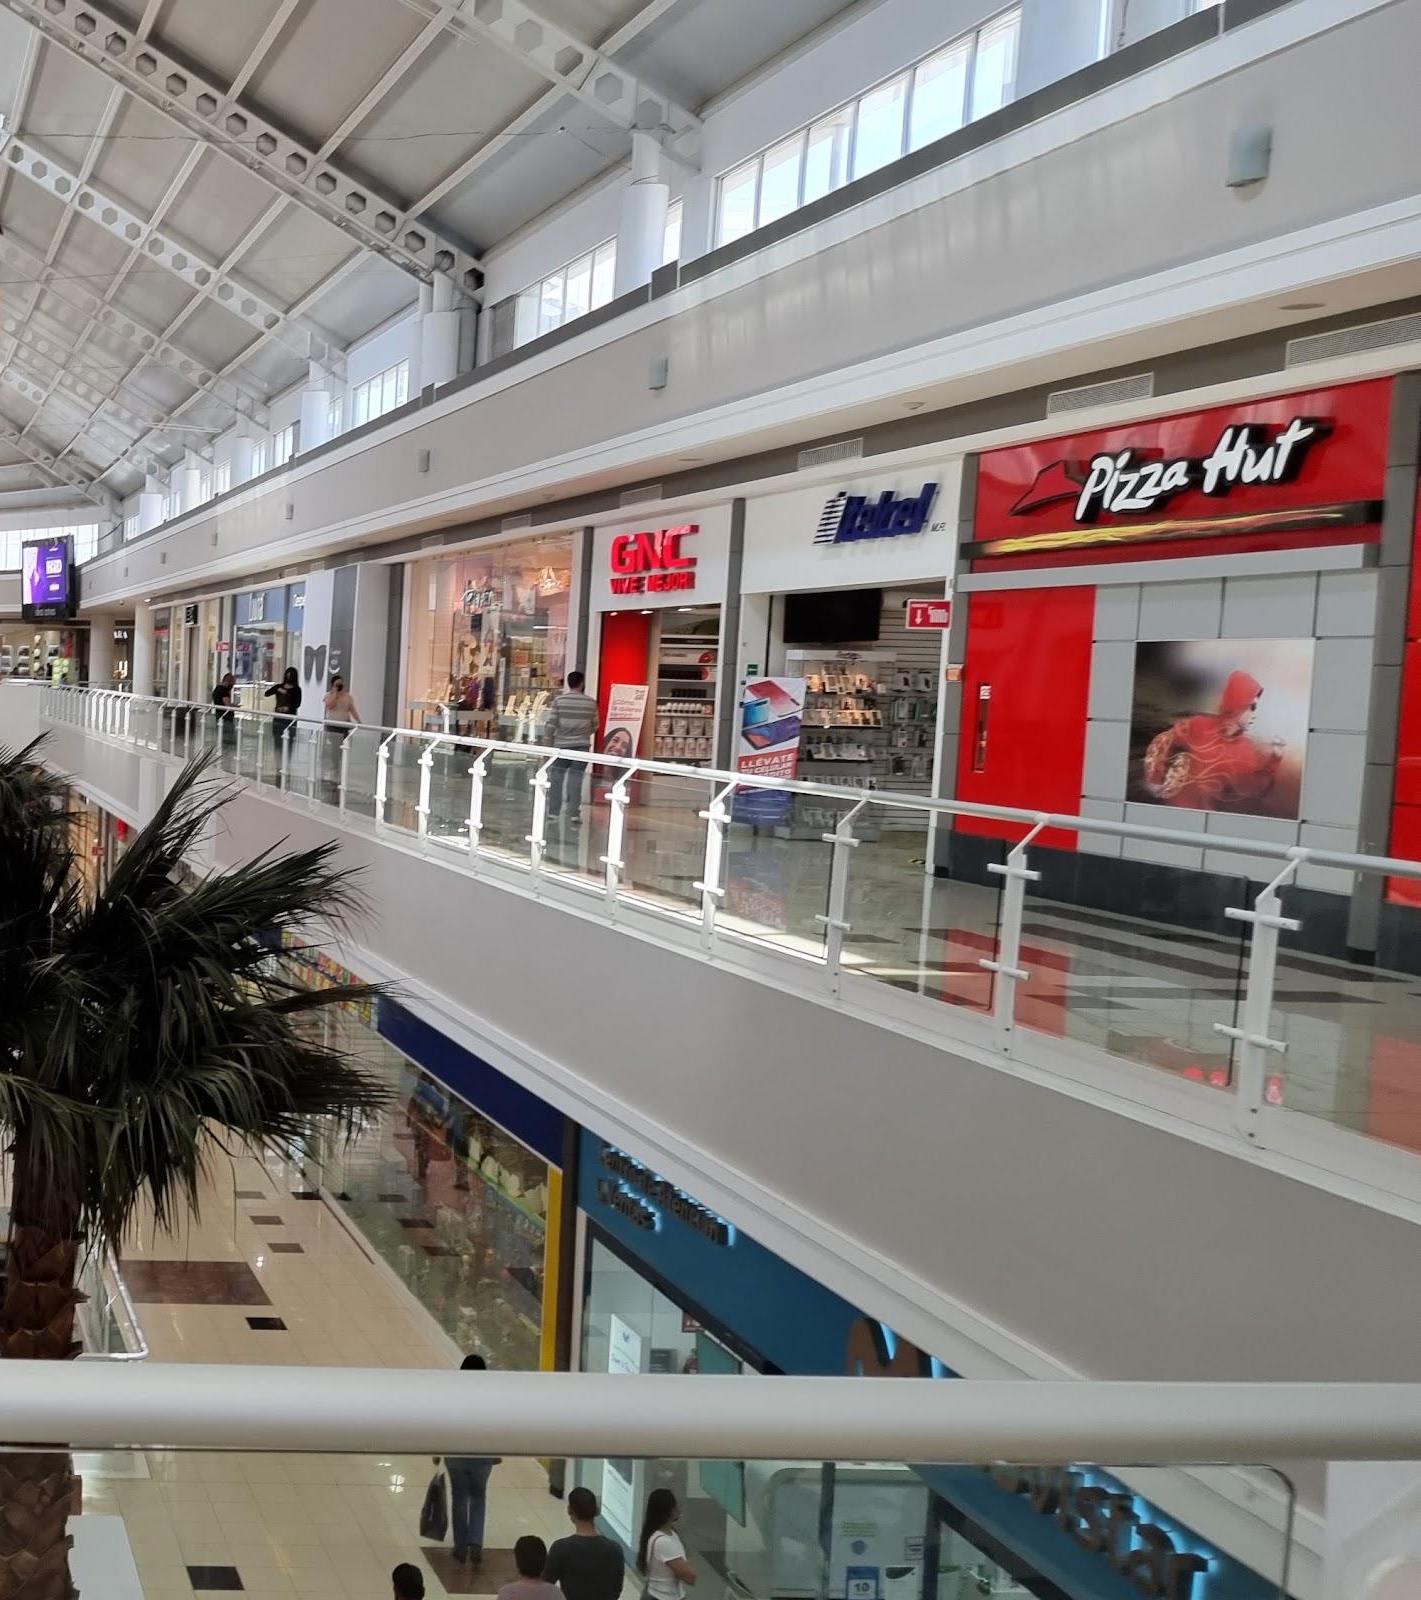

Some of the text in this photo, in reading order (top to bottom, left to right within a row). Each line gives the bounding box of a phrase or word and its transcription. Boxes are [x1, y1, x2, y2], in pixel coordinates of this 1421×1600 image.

[1075, 418, 1315, 521] Pizza Hut
[610, 524, 700, 574] GNC
